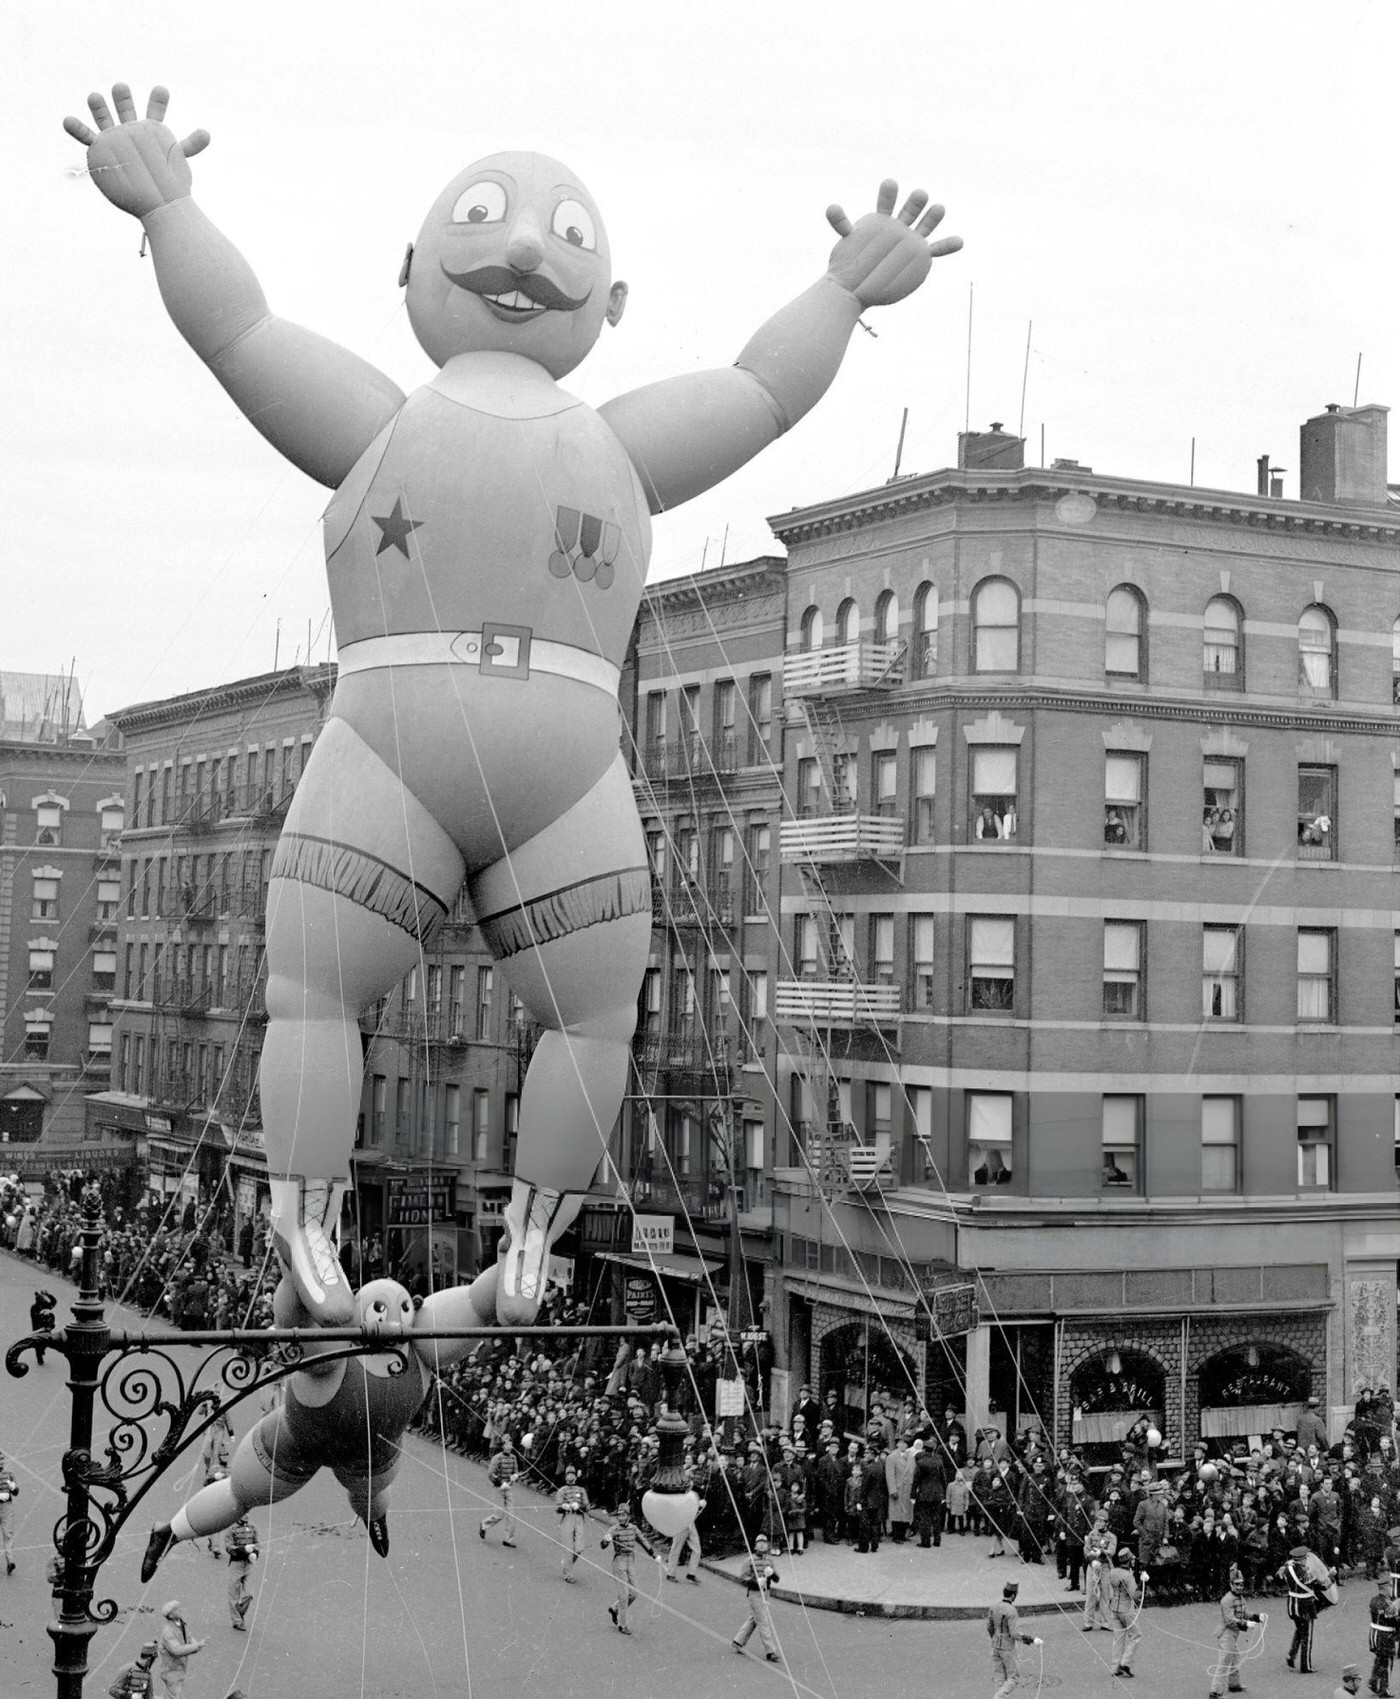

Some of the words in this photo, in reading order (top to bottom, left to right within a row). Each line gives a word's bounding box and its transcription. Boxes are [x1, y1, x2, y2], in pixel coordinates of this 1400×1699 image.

[75, 1149, 119, 1159] LIQUORS
[626, 1290, 655, 1299] PAINTS
[1222, 1374, 1290, 1398] RESTAURANT
[1081, 1387, 1104, 1410] BAR
[1121, 1382, 1153, 1407] GRILL
